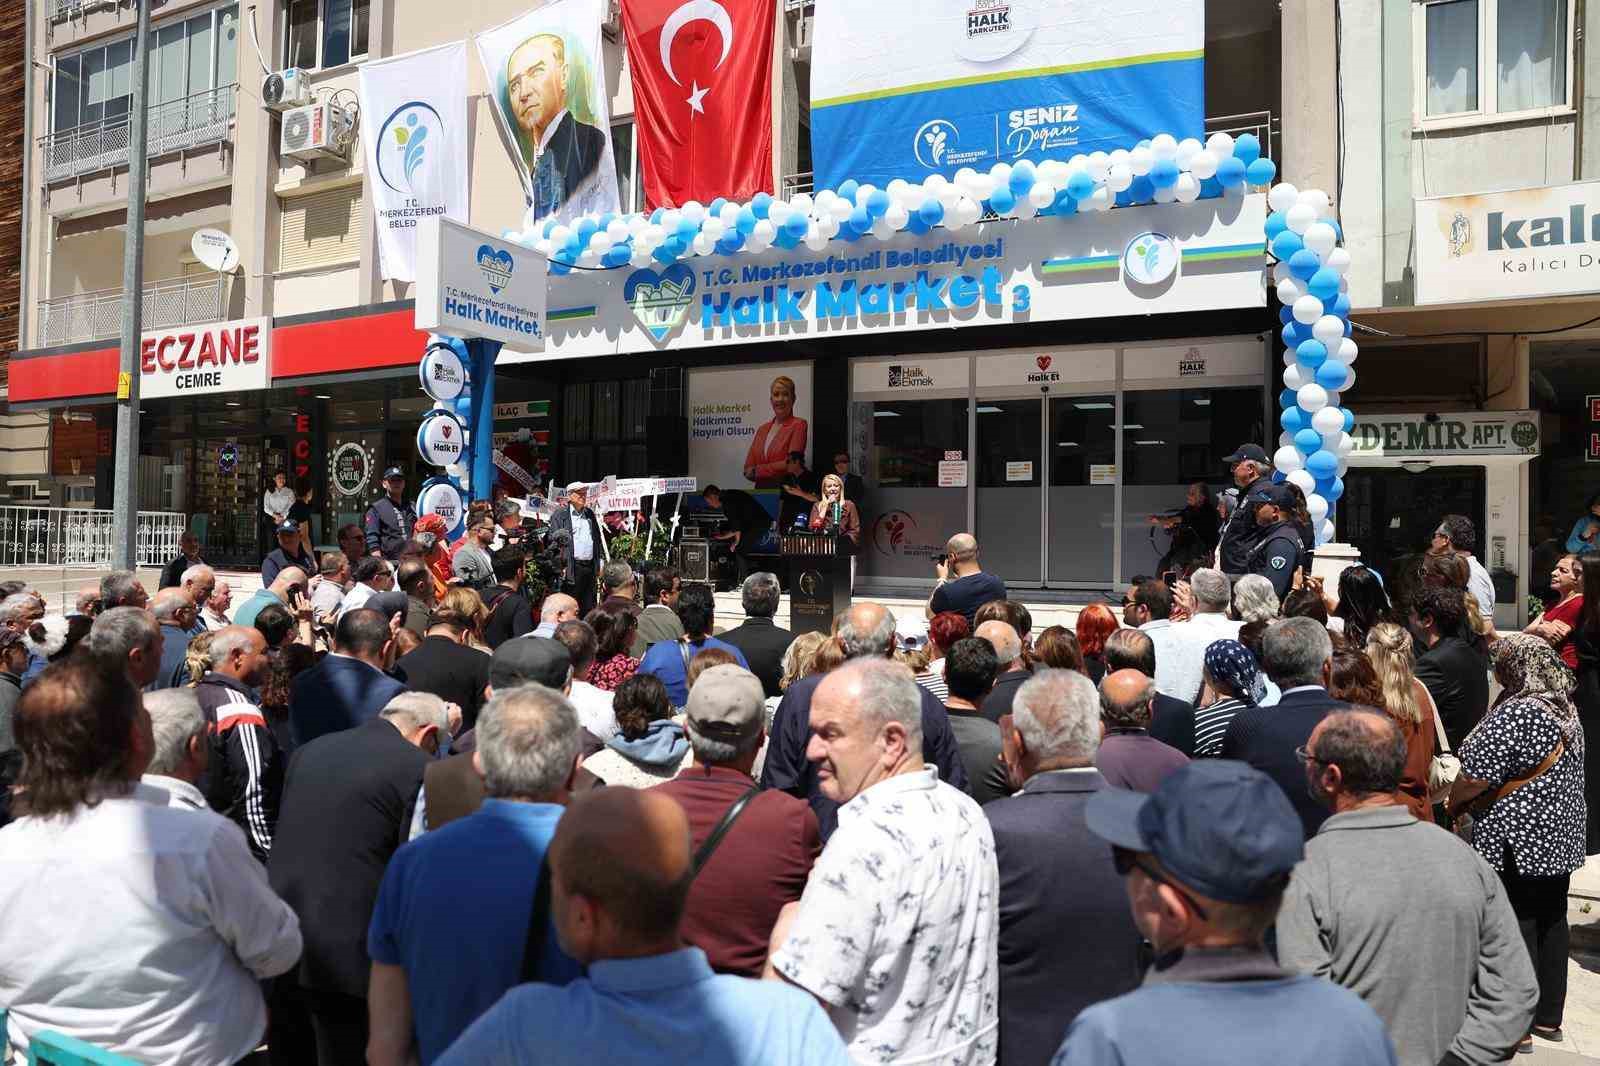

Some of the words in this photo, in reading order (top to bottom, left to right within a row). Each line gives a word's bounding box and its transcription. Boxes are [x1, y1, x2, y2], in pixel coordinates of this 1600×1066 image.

[968, 12, 1009, 28] HALK
[1488, 204, 1600, 251] kal
[703, 270, 738, 287] T.C.
[742, 253, 881, 283] Merkezefendi
[886, 238, 1003, 268] Belediyesi
[1502, 257, 1567, 273] Kalıcı
[446, 287, 459, 297] T.C.
[460, 290, 506, 309] Merkezefendi
[506, 304, 539, 319] Belediyesi
[701, 285, 807, 329] Halk
[816, 264, 1004, 320] Market
[1012, 284, 1031, 312] 3
[445, 297, 481, 321] Halk
[485, 309, 538, 336] Market
[141, 325, 259, 373] ECZANE
[902, 367, 924, 378] Halk
[1180, 362, 1205, 371] HALK
[176, 372, 221, 389] CEMRE
[902, 376, 935, 387] Ekmek
[1028, 373, 1049, 383] Halk
[1050, 372, 1060, 382] Et
[497, 406, 519, 417] İLAÇ
[693, 404, 715, 415] Halk
[716, 403, 752, 414] Market
[693, 416, 742, 427] Halkımıza
[692, 428, 725, 440] Hayırlı
[727, 426, 755, 437] Olsun
[1473, 425, 1507, 445] APT.
[433, 443, 451, 452] Halk
[451, 444, 459, 453] Et
